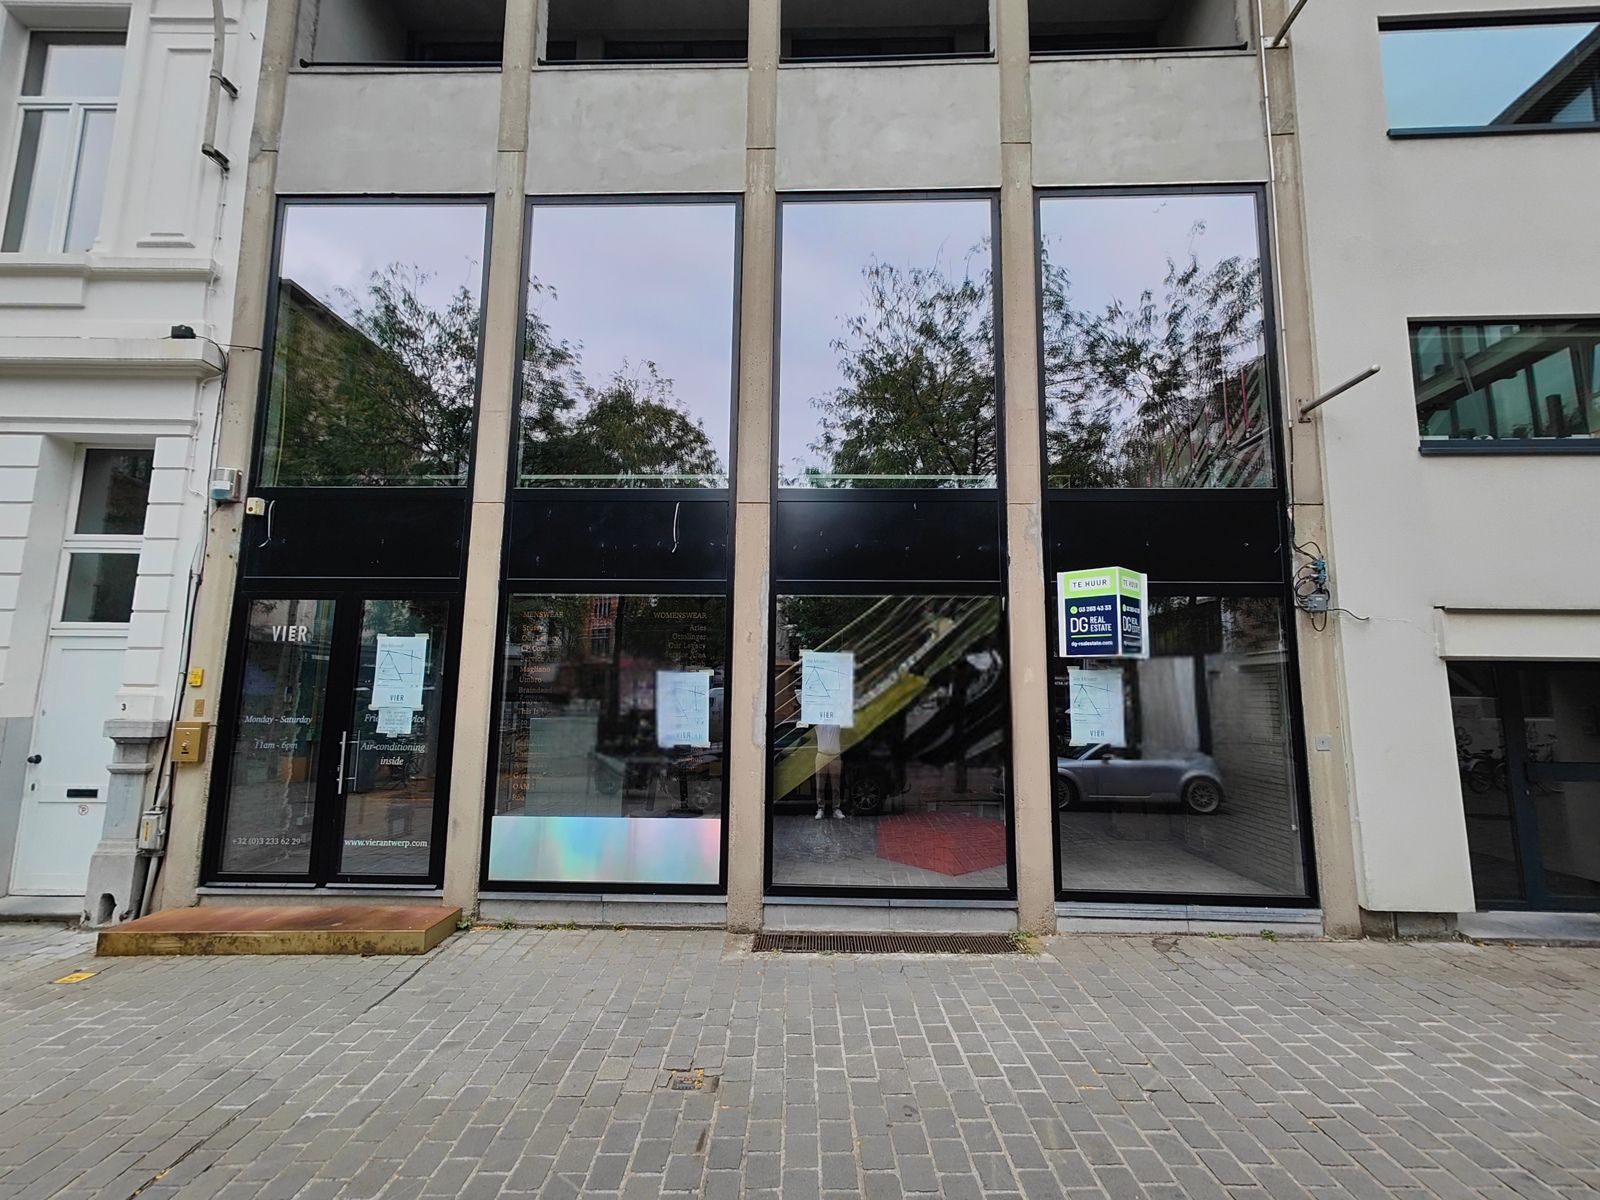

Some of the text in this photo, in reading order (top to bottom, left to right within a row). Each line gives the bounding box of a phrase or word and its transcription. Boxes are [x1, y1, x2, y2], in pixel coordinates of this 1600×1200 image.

[1085, 579, 1107, 587] HUUR
[653, 611, 707, 619] WOMENSWEAR
[1070, 616, 1106, 633] DG REAL
[1090, 623, 1112, 632] ESTATE
[1122, 616, 1131, 632] DG
[272, 625, 308, 642] VIER
[1071, 640, 1113, 648] dg-realestate.com
[390, 694, 404, 702] VIER
[121, 703, 127, 711] 3
[244, 715, 274, 725] Monday
[279, 715, 313, 725] Saturday
[1089, 729, 1105, 737] VIER
[254, 740, 275, 749] 11am
[281, 740, 298, 751] 6pm
[360, 742, 425, 753] Air-conditioning
[380, 756, 404, 765] inside
[232, 837, 247, 846] +32
[248, 837, 264, 847] (0)3
[344, 838, 428, 849] www.vierantwerp.com
